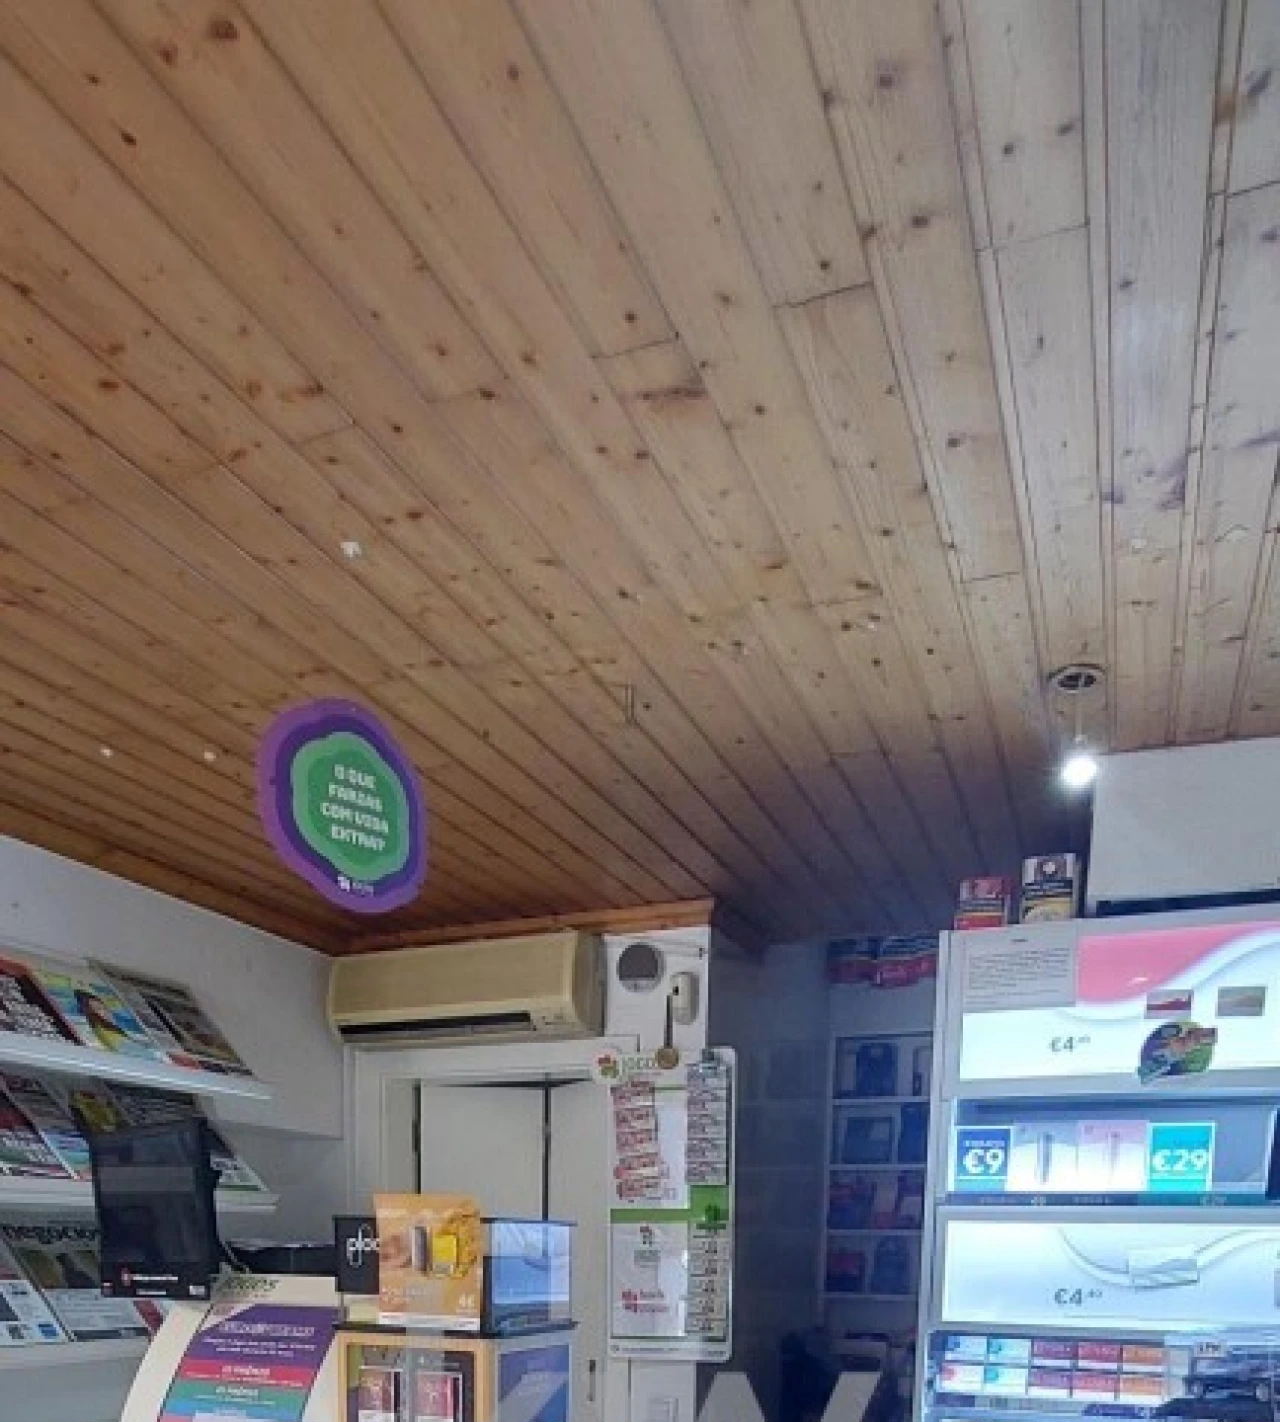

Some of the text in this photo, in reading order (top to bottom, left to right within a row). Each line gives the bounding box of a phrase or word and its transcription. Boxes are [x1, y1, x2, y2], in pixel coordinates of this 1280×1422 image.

[334, 764, 346, 780] O
[962, 1148, 1006, 1176] €9
[1152, 1147, 1209, 1173] €29
